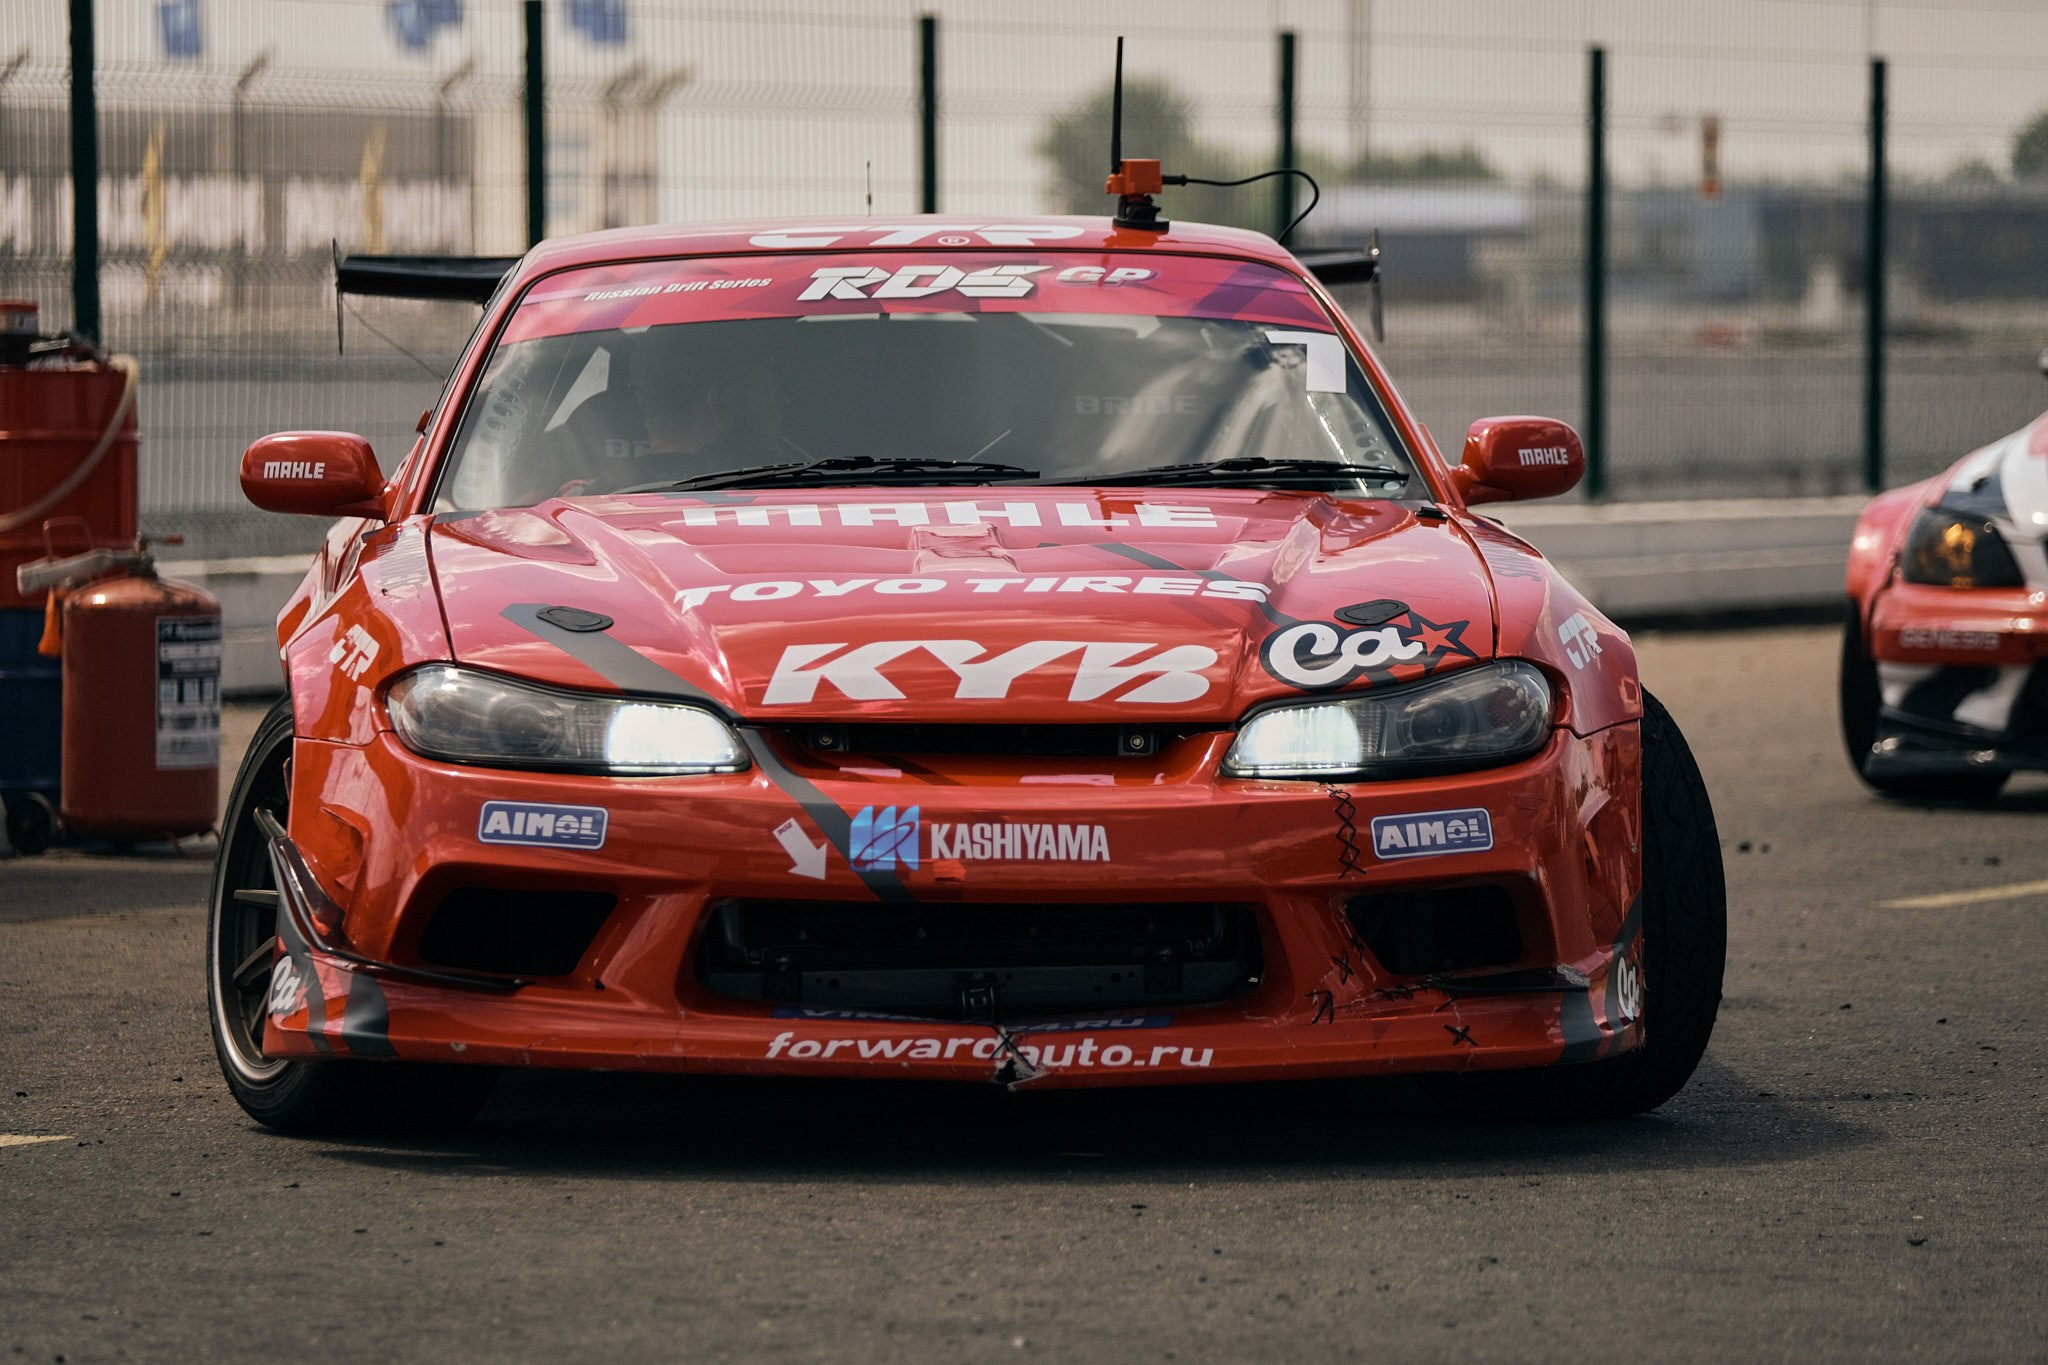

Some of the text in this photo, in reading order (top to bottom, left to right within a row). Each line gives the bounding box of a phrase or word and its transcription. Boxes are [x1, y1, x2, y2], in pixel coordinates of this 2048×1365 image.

[583, 277, 773, 302] Russian Drift Series
[796, 264, 1151, 301] RDS GP
[263, 460, 326, 479] MAHLE
[1518, 447, 1569, 466] MAHLE
[683, 501, 1218, 528] MAHLE
[675, 576, 1272, 614] TOYO TIRES
[762, 639, 1219, 705] KYB
[483, 810, 600, 840] AIMOL
[1379, 817, 1488, 850] AIMOL
[930, 822, 1111, 862] KASHIYAMA
[764, 1031, 1215, 1070] forwardauto.ru
